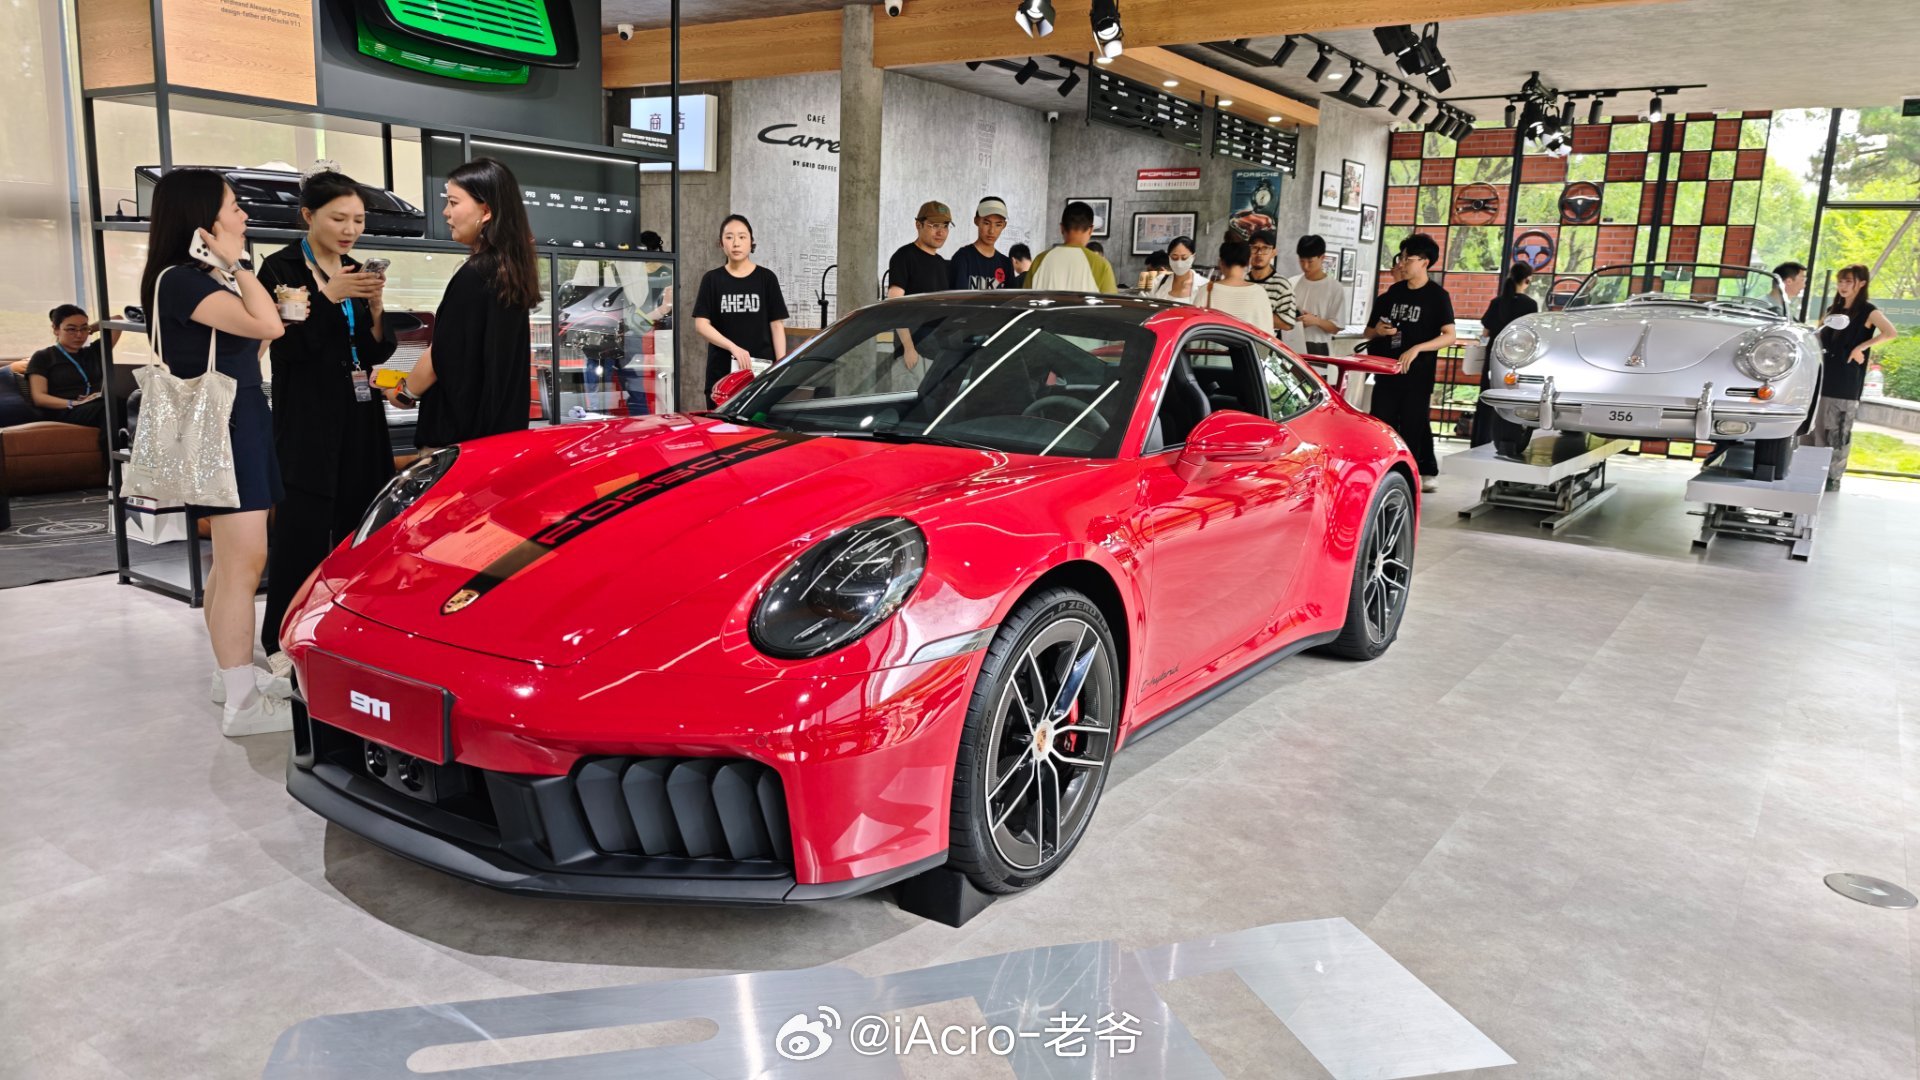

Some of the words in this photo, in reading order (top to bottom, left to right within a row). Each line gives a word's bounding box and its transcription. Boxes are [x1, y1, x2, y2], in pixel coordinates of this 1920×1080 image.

[807, 113, 826, 125] CAFÉ
[757, 123, 840, 153] Carre
[802, 161, 815, 169] GRID
[720, 293, 761, 313] AHEAD
[1390, 303, 1421, 322] AHEAD
[1608, 410, 1633, 422] 356
[536, 438, 788, 545] PORSCHE
[1068, 601, 1098, 616] ZERO
[350, 690, 391, 722] 911
